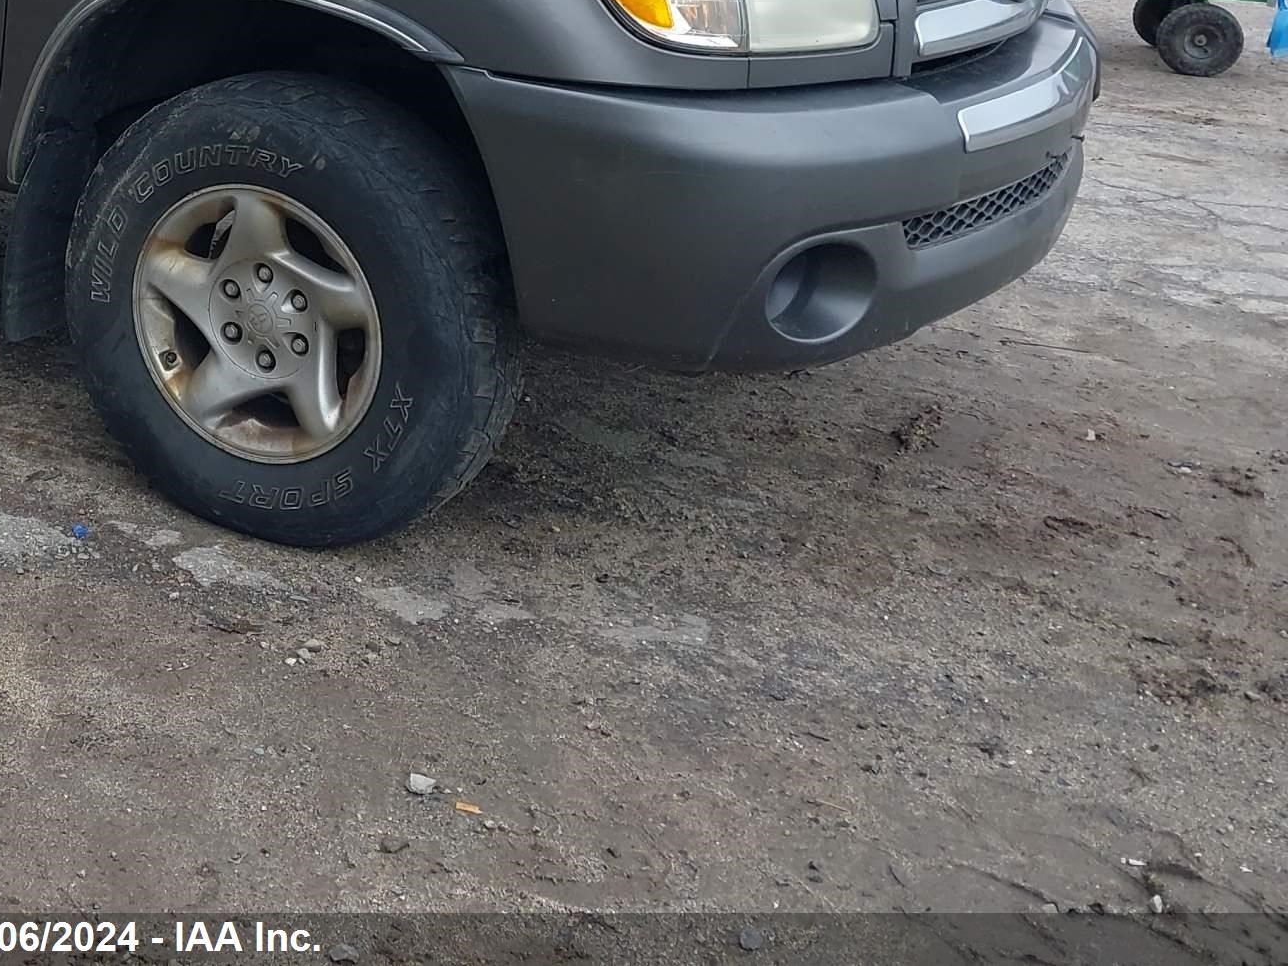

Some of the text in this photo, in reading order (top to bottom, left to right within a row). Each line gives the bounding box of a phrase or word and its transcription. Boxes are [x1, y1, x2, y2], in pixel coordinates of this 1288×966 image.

[91, 144, 304, 303] WILD COUNTRY
[218, 382, 414, 510] XTX SPORT
